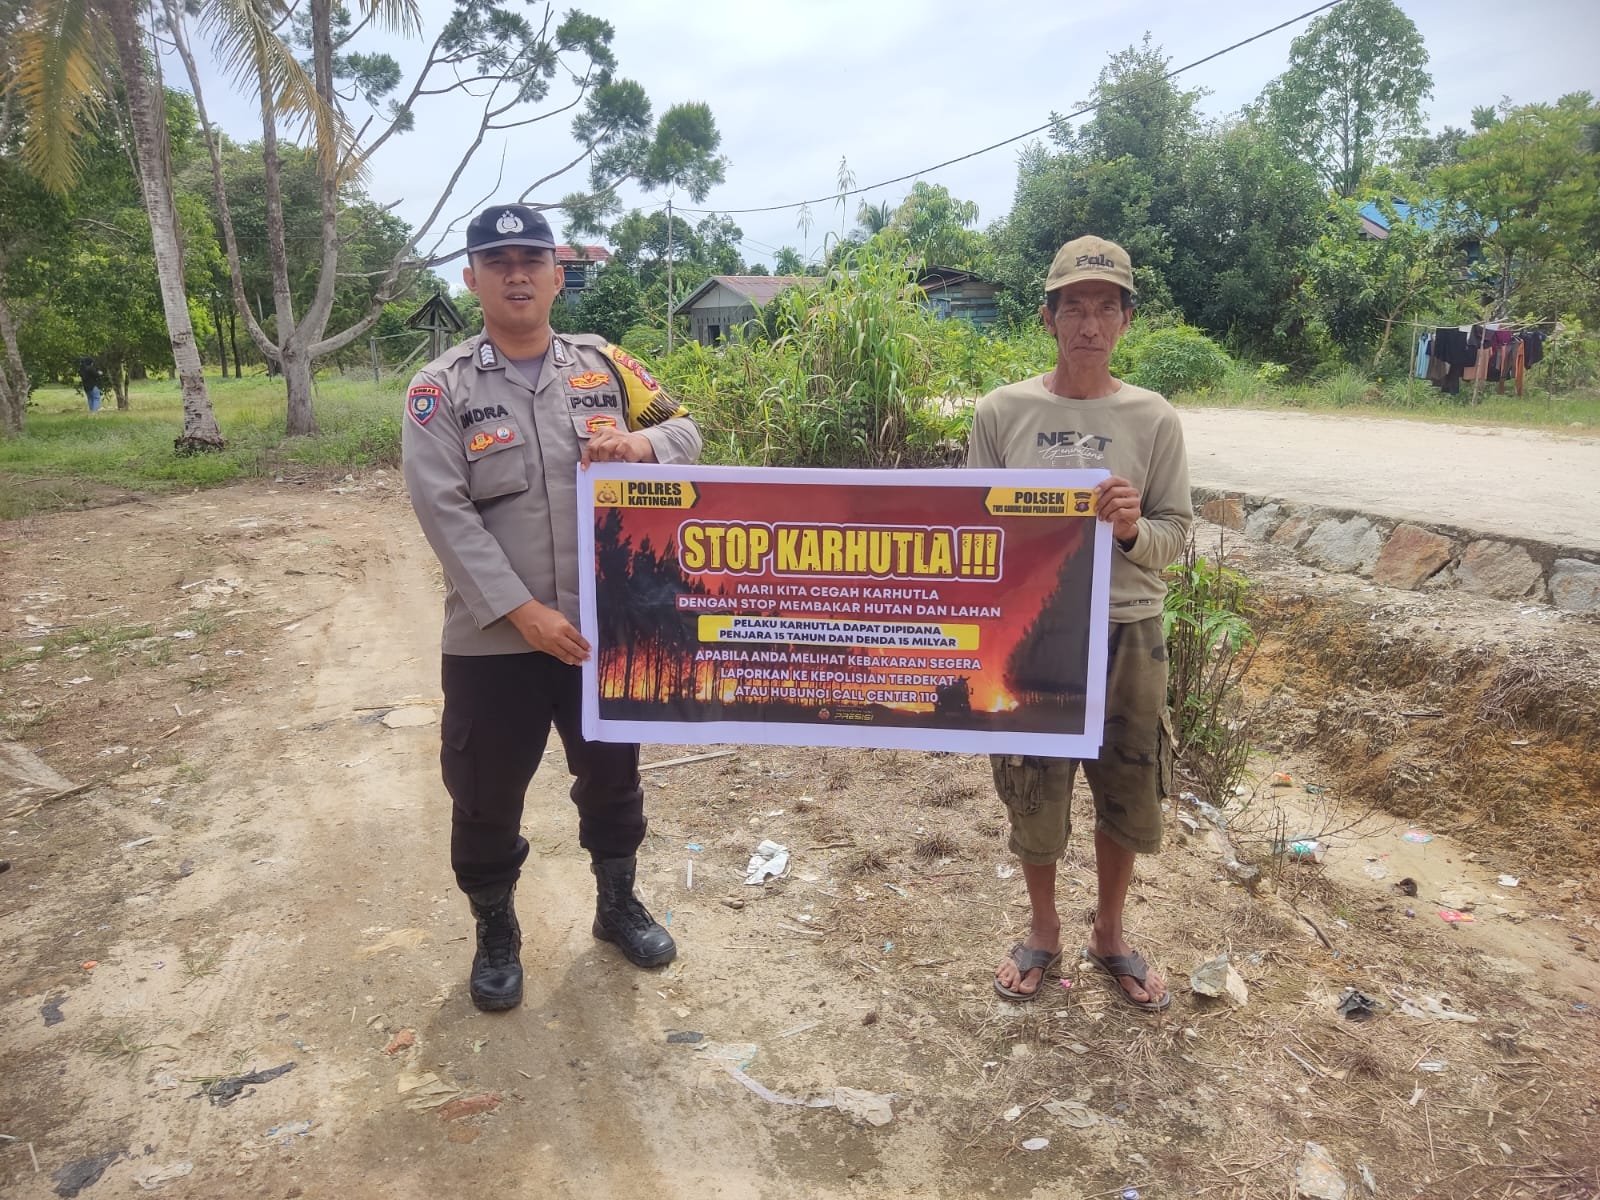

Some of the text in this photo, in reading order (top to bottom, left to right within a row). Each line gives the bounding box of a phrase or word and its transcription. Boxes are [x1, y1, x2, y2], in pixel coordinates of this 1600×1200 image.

[570, 393, 618, 409] POLRI
[460, 404, 509, 429] INDRA
[1037, 431, 1112, 451] NEXT
[628, 482, 682, 495] POLRES
[628, 496, 682, 506] KATINGAN
[1014, 491, 1065, 504] POLSEK
[684, 525, 997, 575] STOP KARHUTLA !!!
[737, 583, 939, 600] MARI KITA CEGAH KARHUTLA
[679, 597, 1001, 617] DENGAN STOP MEMBAKAR HUTAN DAN LAHAN
[734, 619, 941, 635] PELAKU KARHUTLA DAPAT DIPIDANA
[719, 630, 956, 647] PENJARA 15 TAHUN DAN DENDA 15 MILYAR
[695, 650, 981, 670] APABILA ANDA MELIHAT KEBAKARAN SEGERA
[720, 668, 955, 686] LAPORKAN KE KEPOLISIAN TERDEKAT
[735, 686, 938, 702] ATAU HUBUNGI CALL CENTER 110
